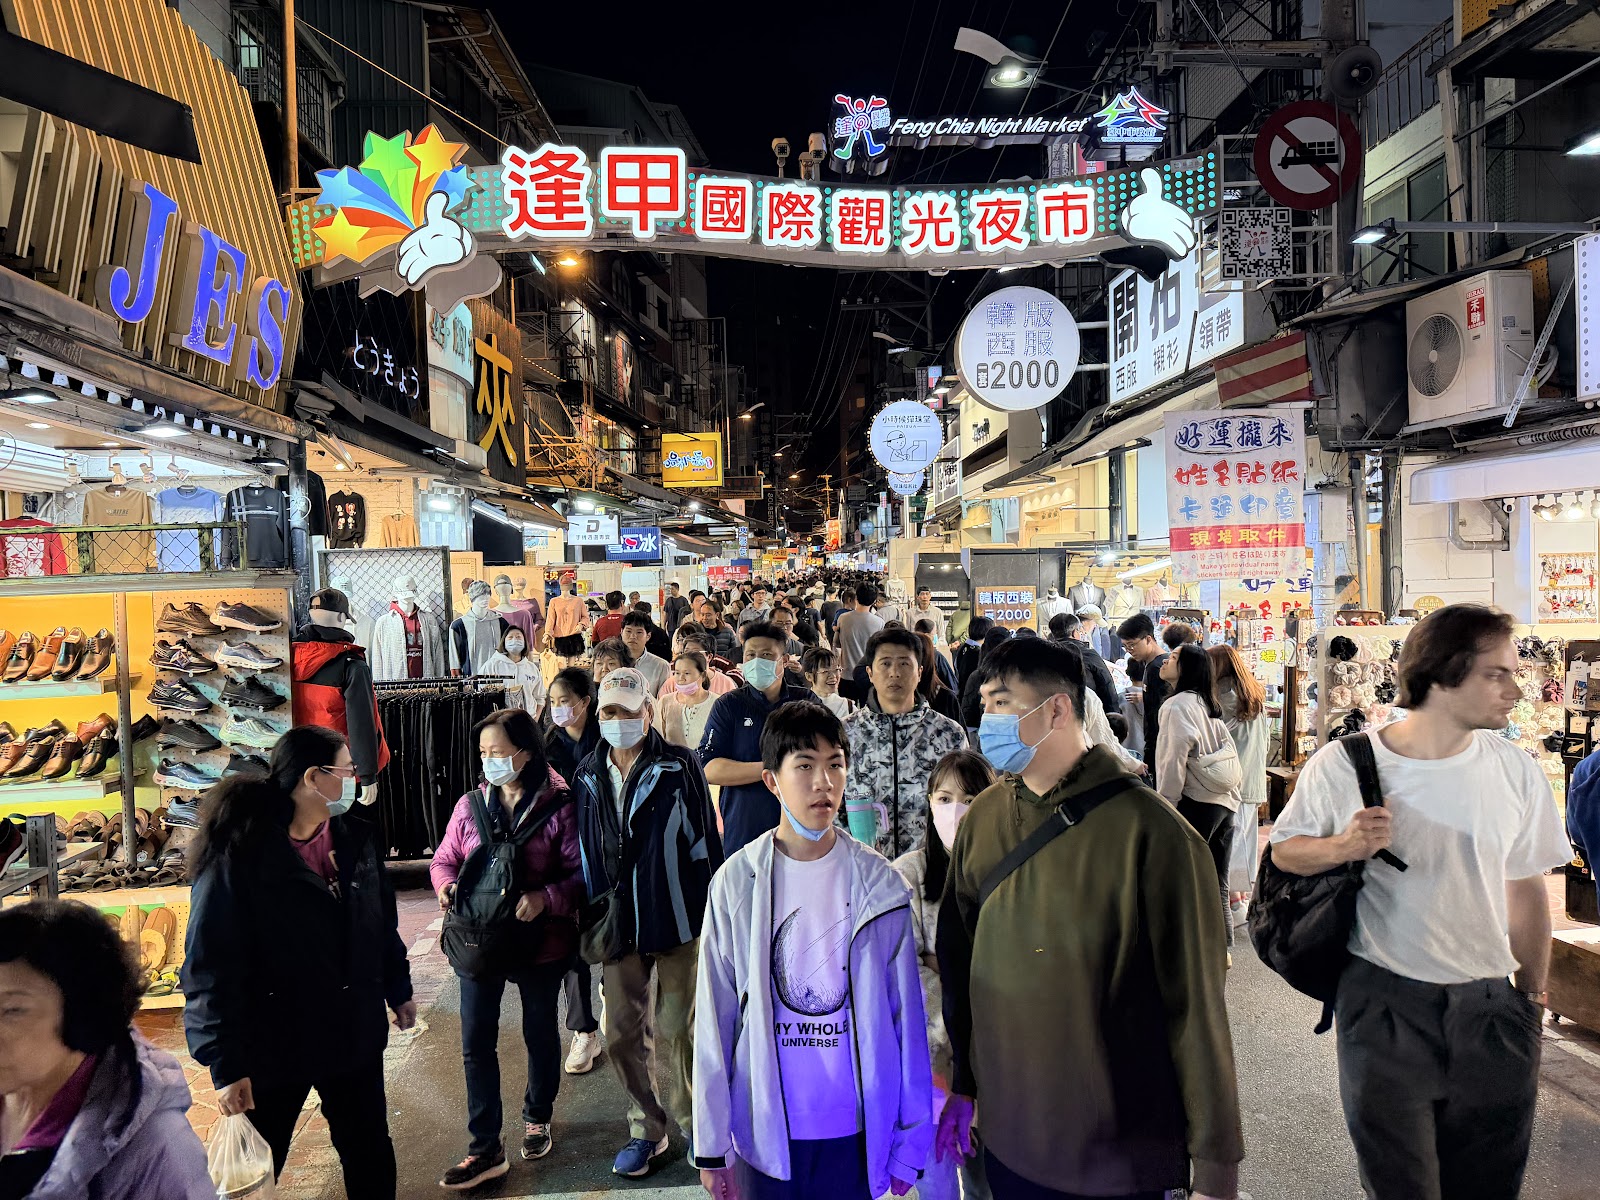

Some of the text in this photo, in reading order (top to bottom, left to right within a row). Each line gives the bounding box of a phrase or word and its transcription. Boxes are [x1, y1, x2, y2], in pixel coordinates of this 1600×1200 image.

[890, 116, 1088, 138] Feng Chia Night Market
[504, 147, 1090, 249] 逢甲國際觀光夜市
[108, 181, 292, 390] JES
[986, 301, 1054, 328] 韓版
[986, 330, 1054, 357] 西服
[1115, 307, 1232, 393] 西服 襯衫 領帶
[353, 329, 420, 400] とうきょう
[990, 360, 1059, 389] 2000
[1177, 417, 1292, 449] 好運攏來
[1174, 459, 1299, 487] 姓名貼紙
[1179, 487, 1296, 522] 卡通印章
[1189, 526, 1287, 546] 現場取件
[723, 566, 741, 574] SALE
[978, 590, 1034, 605] 韓版西裝
[996, 608, 1032, 621] 2000
[781, 1037, 839, 1047] UNIVERSE
